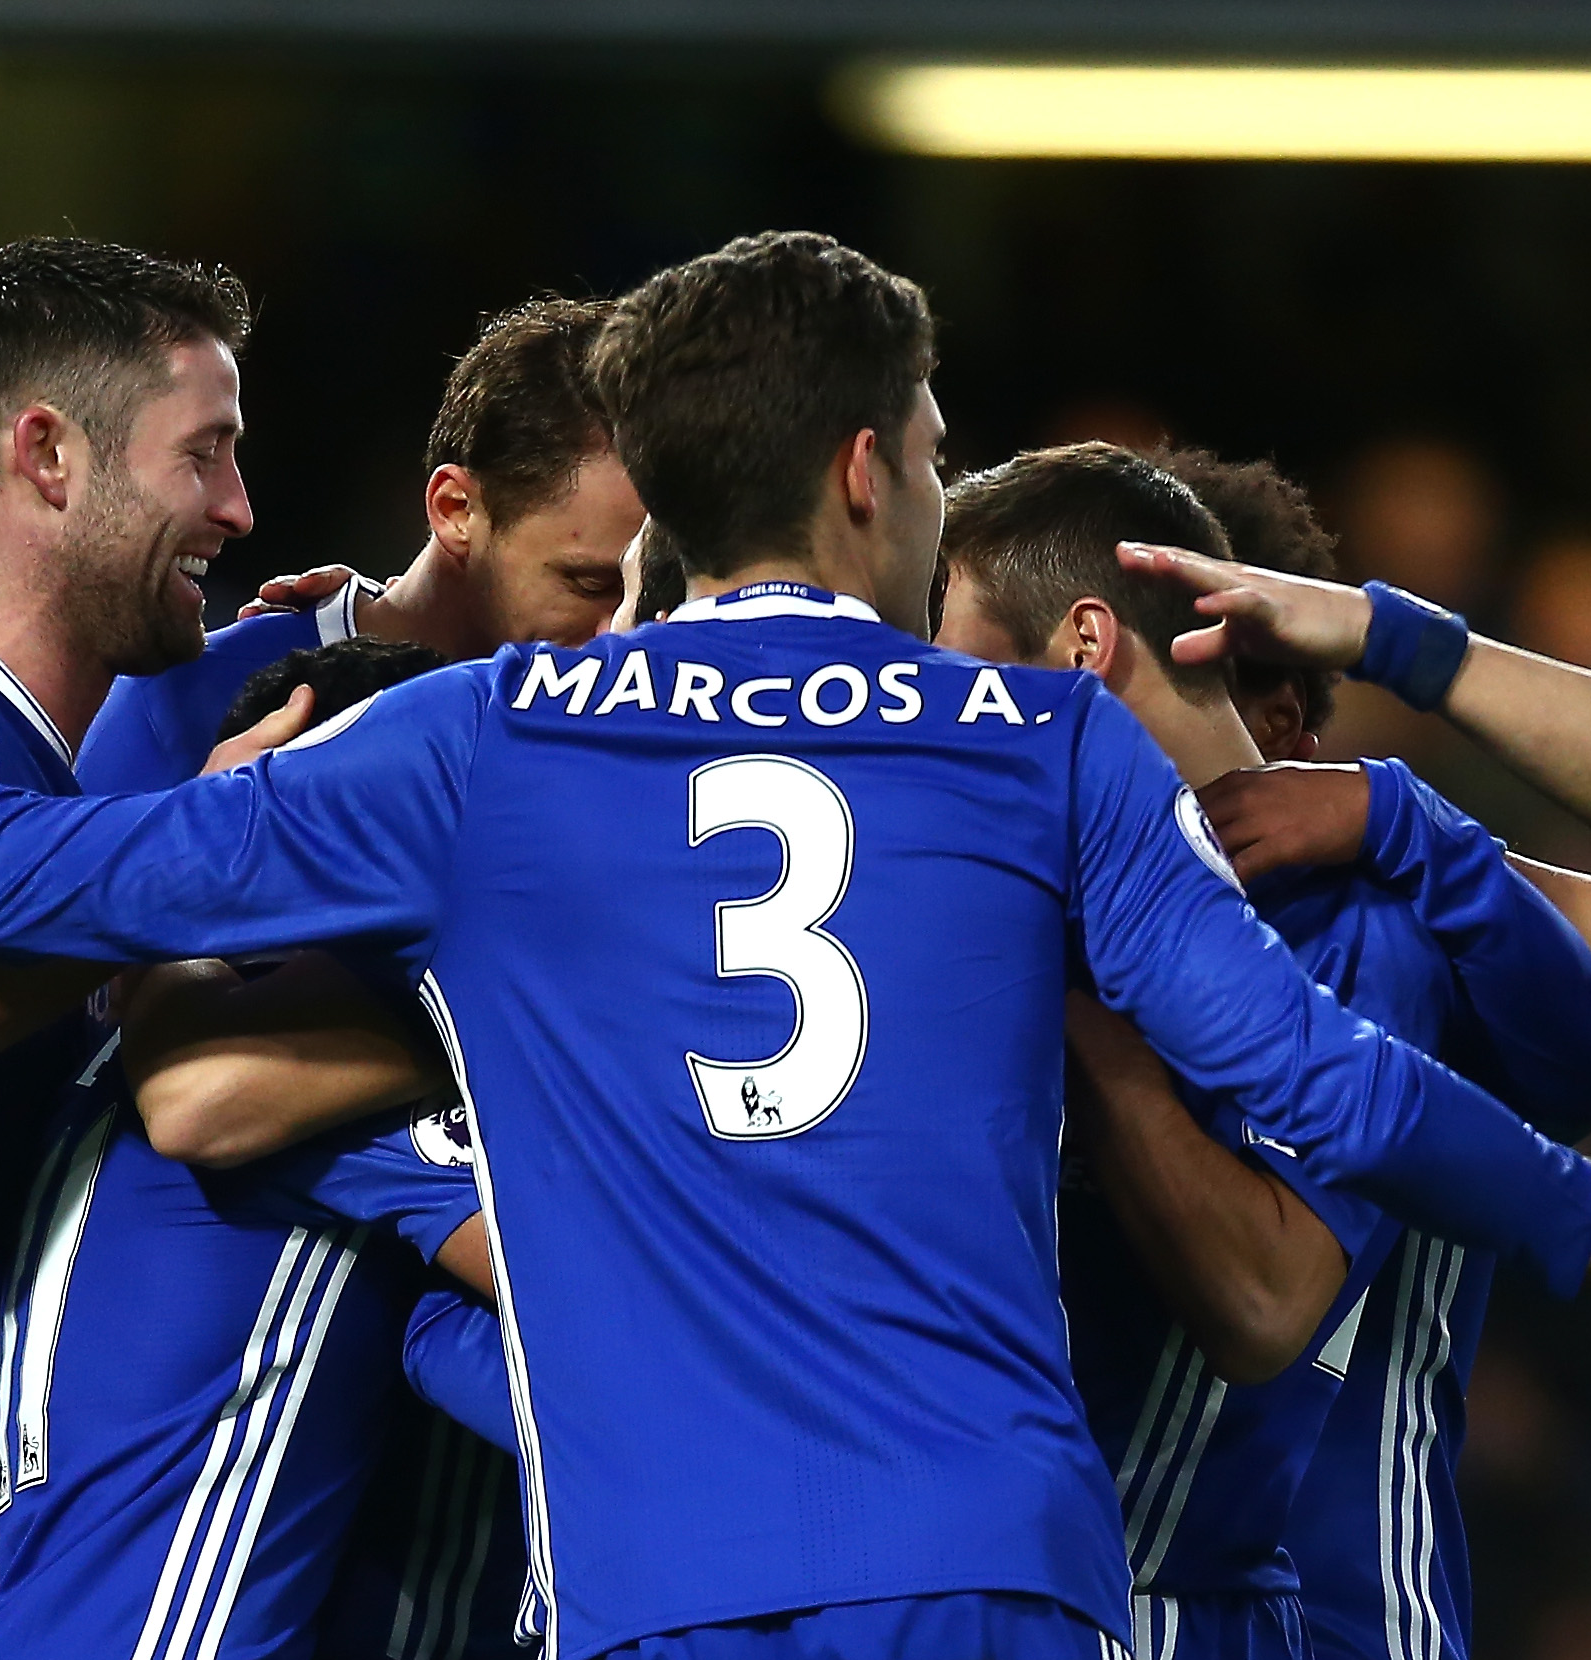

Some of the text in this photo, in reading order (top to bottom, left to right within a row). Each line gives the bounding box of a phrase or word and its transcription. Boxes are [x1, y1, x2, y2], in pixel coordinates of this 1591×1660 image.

[511, 649, 1053, 727] MARCOS A.
[686, 753, 870, 1141] 3
